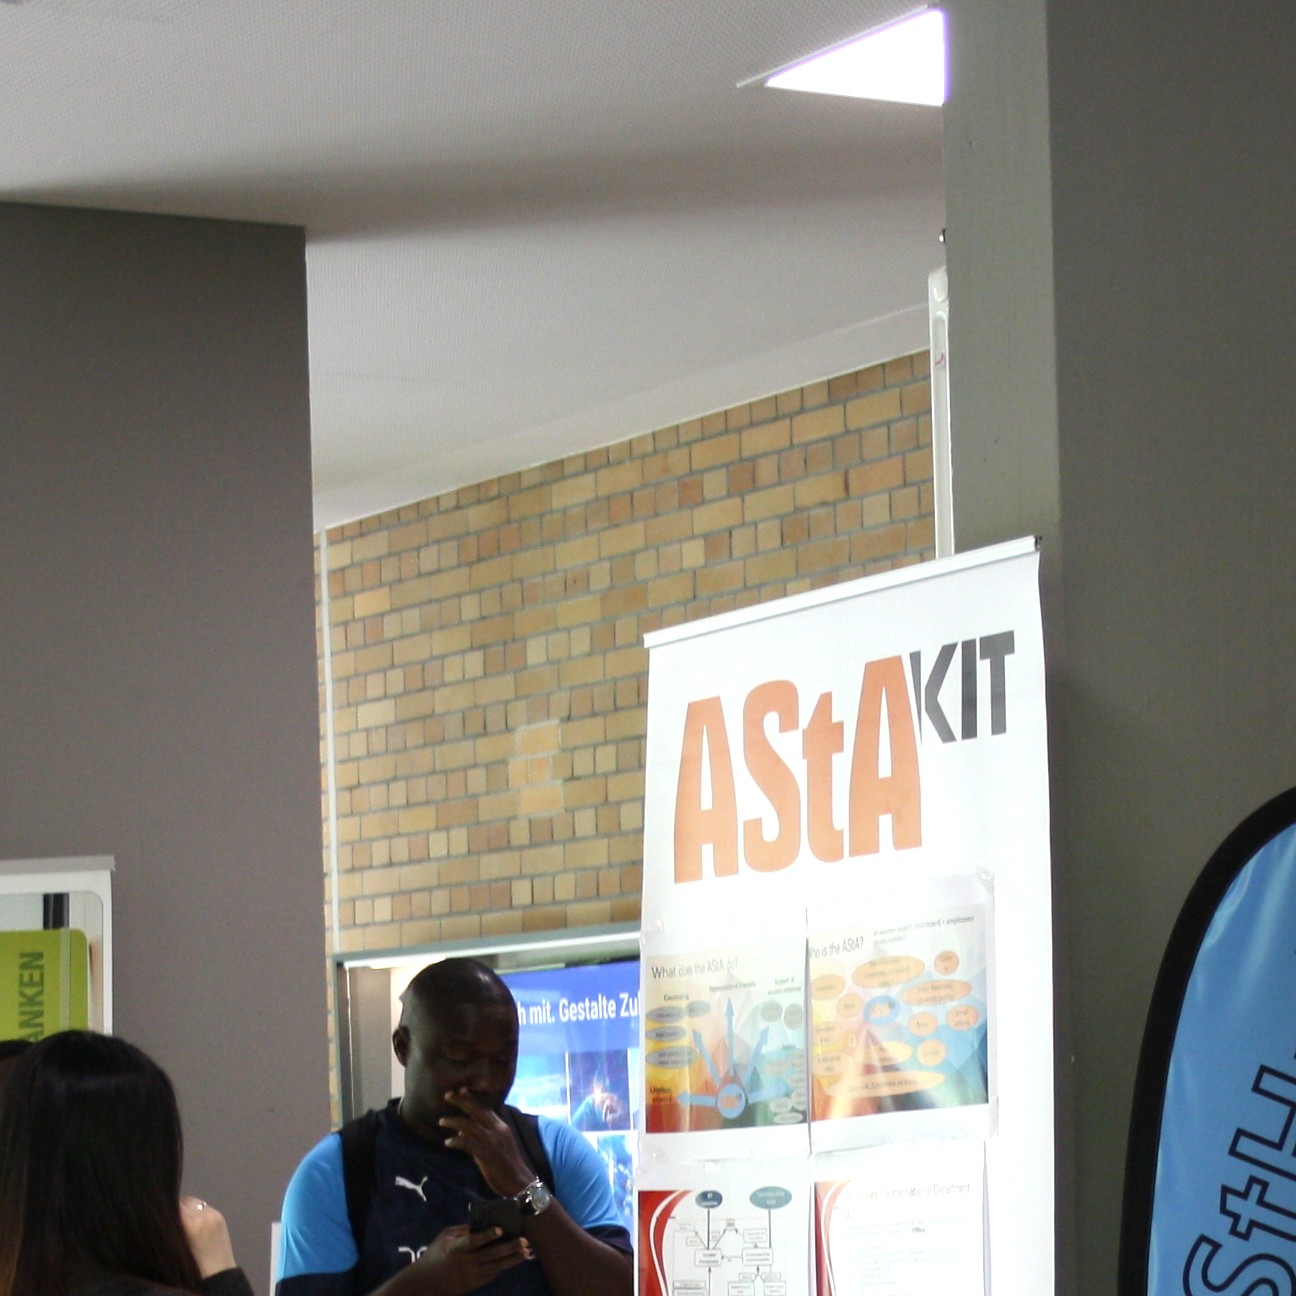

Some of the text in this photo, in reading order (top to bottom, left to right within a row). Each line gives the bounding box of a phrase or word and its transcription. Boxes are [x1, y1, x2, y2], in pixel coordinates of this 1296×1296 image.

[673, 629, 1015, 885] AStA KIT
[529, 998, 556, 1025] mit.
[558, 992, 617, 1023] Gestalte
